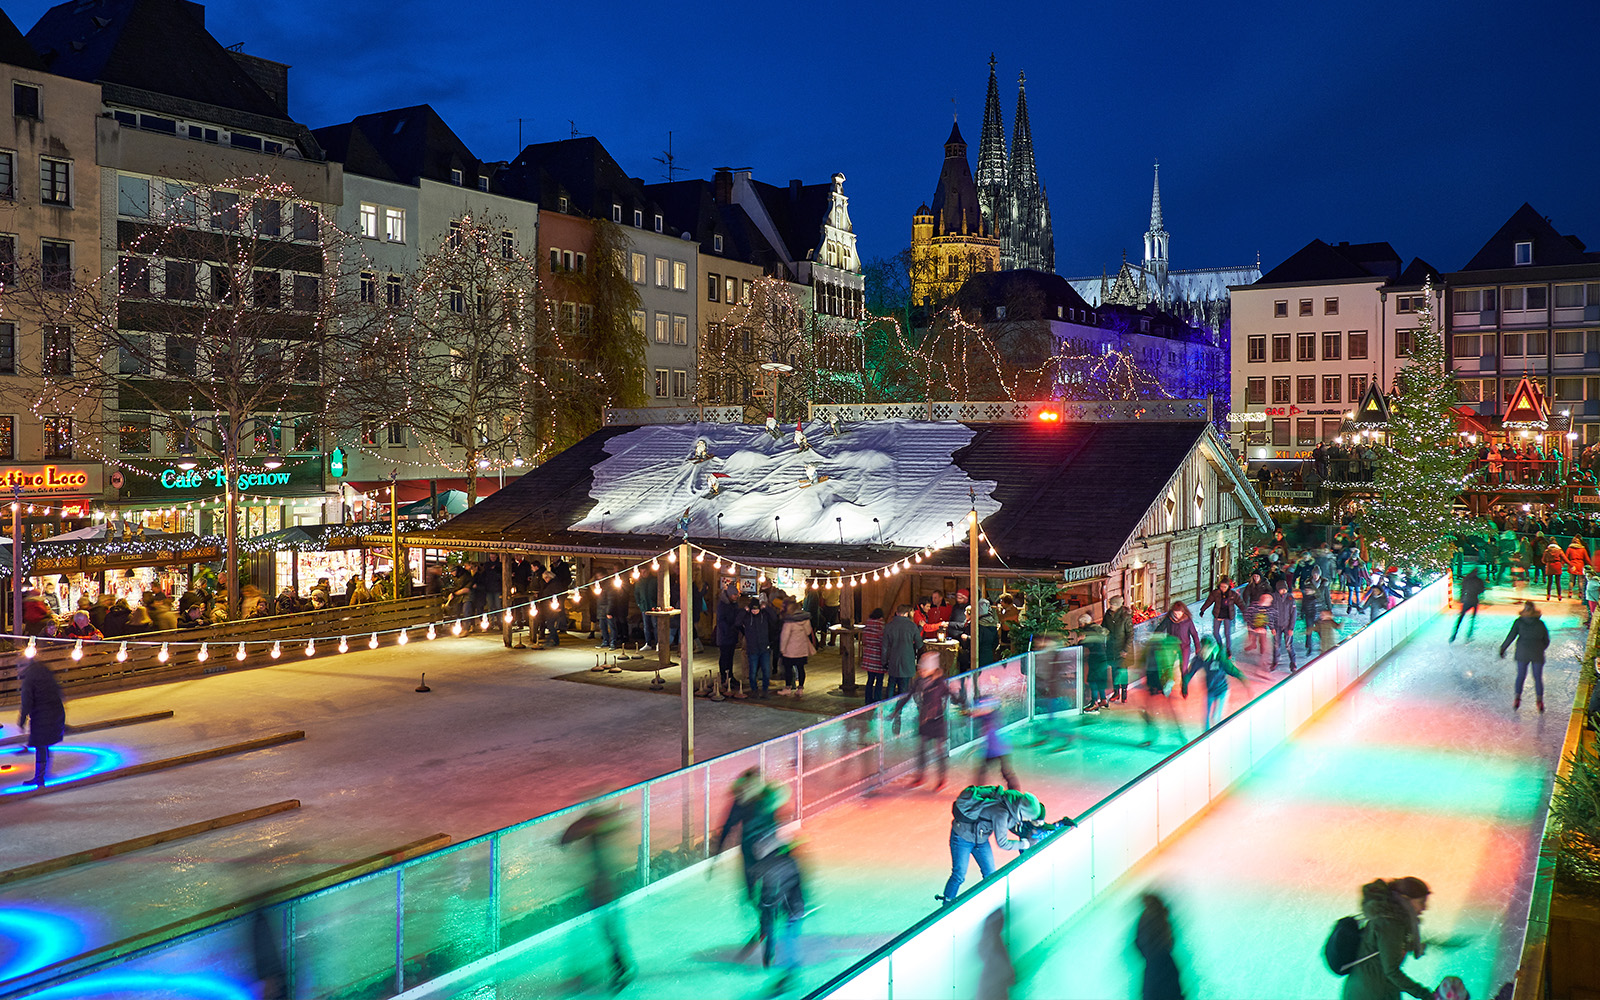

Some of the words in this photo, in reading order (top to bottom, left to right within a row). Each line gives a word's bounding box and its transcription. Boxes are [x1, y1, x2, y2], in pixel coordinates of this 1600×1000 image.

[1264, 407, 1286, 416] GAG
[1275, 450, 1290, 459] XII
[47, 466, 87, 486] Loco
[208, 468, 291, 491] Rsenow
